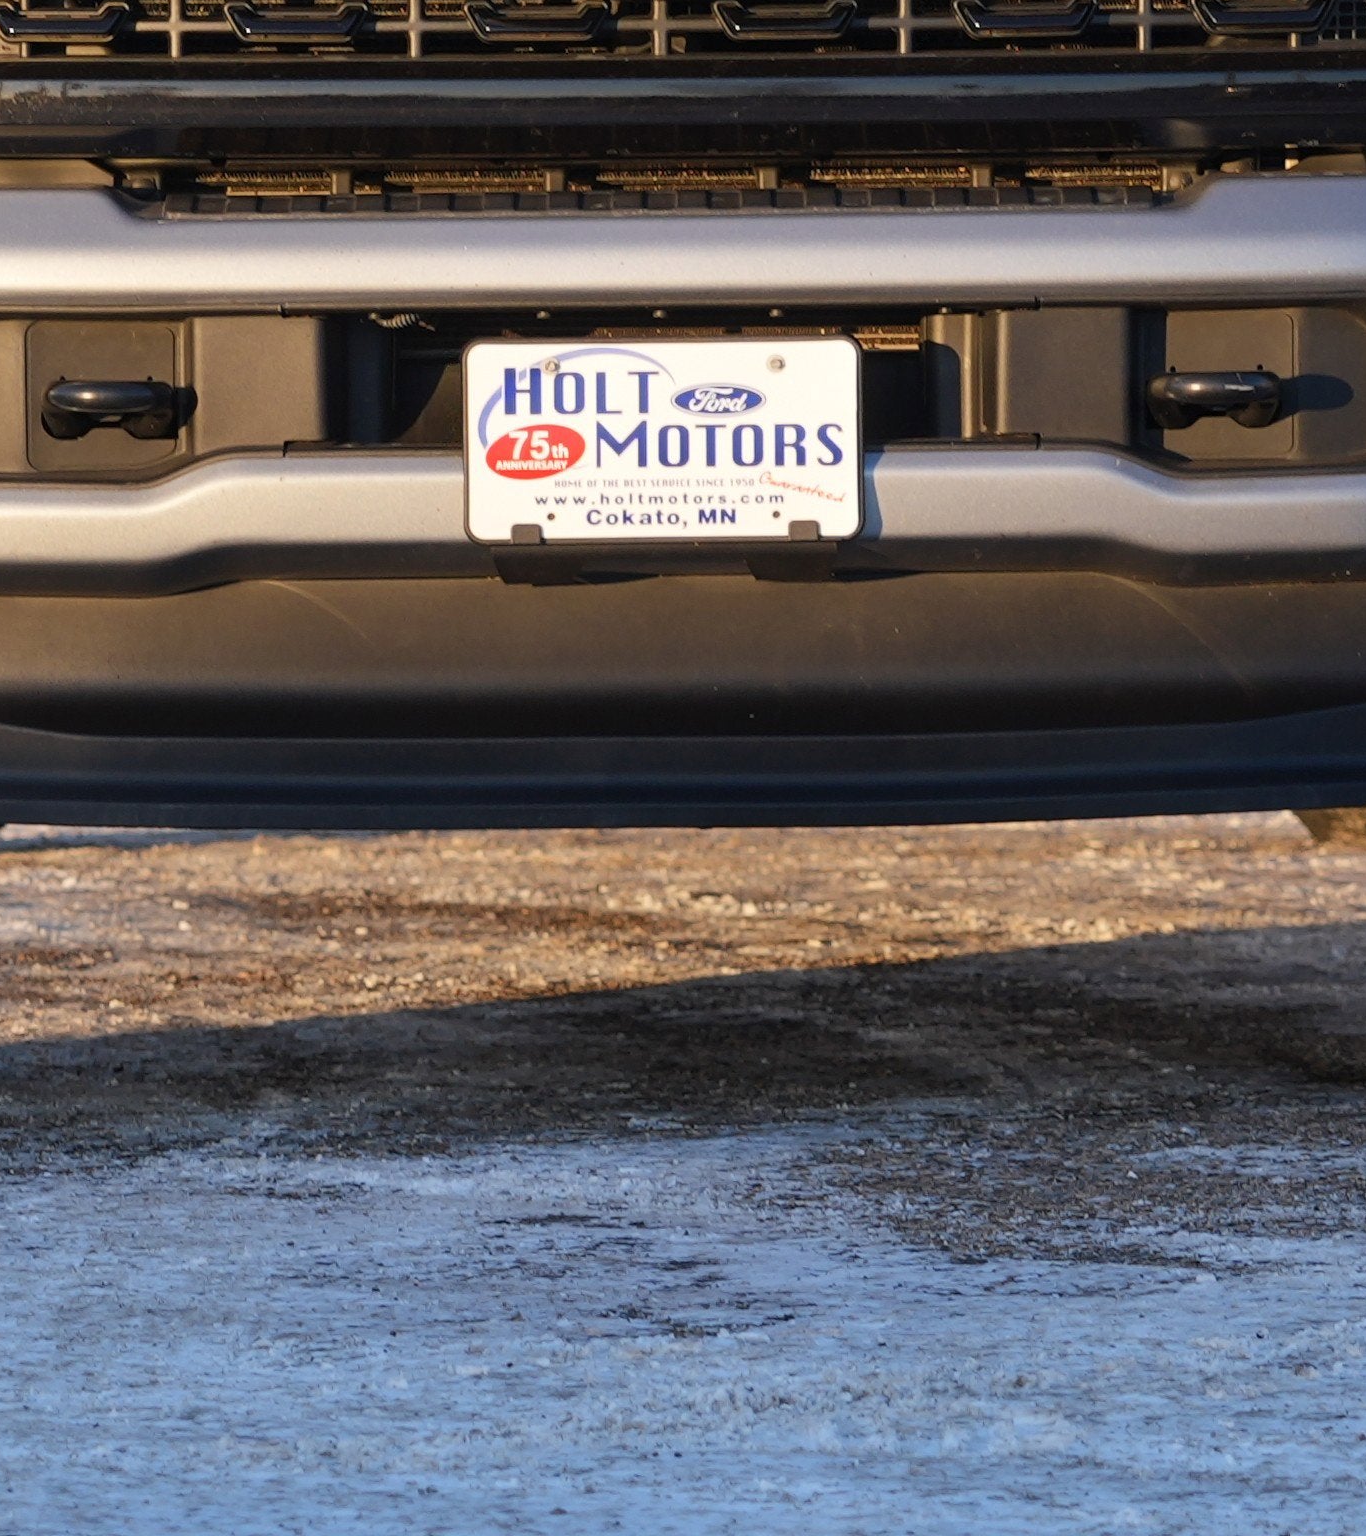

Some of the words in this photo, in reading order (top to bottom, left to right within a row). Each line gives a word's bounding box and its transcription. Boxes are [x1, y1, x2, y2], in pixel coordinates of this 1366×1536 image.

[503, 367, 660, 415] HOLT
[688, 386, 748, 413] Ford
[508, 430, 570, 460] 75th
[596, 420, 844, 468] MOTORS
[495, 459, 568, 471] ANNIVERSARY
[554, 479, 582, 488] HOME
[587, 479, 597, 488] OF
[603, 479, 619, 488] THE
[624, 479, 647, 488] BEST
[651, 479, 690, 487] SERVICE
[696, 478, 724, 487] SINCE
[730, 478, 755, 487] 1950
[759, 471, 846, 502] Guaranteed
[535, 493, 784, 505] www.holtmotors.com
[586, 509, 688, 528] Cokato,
[698, 508, 736, 524] MN
